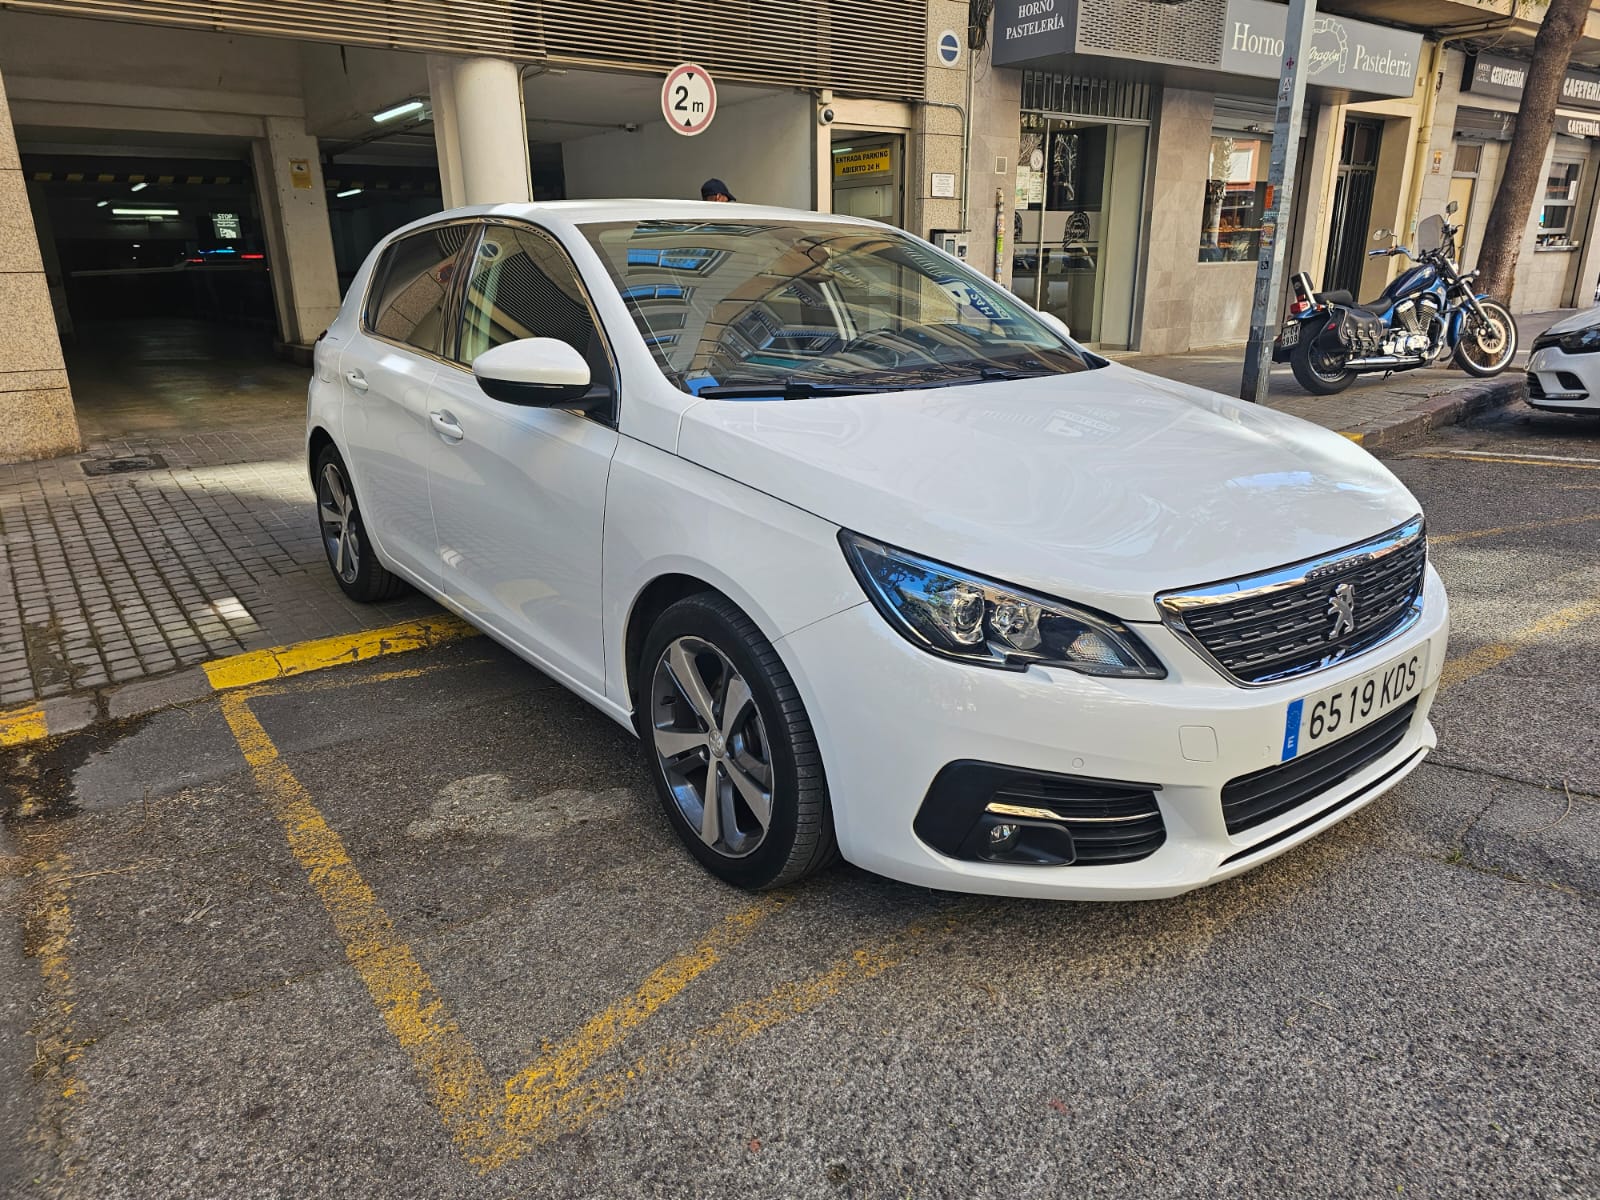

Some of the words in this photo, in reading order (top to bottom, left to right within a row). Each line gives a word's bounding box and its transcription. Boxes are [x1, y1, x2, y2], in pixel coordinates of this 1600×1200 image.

[1018, 0, 1054, 18] HORNO
[1006, 13, 1064, 39] PASTELERÍA
[1232, 22, 1284, 57] Horno
[674, 85, 689, 111] 2
[692, 101, 704, 113] m
[836, 154, 862, 164] ENTRADA
[862, 150, 888, 161] PARKING
[842, 164, 866, 174] ABIERTO
[875, 162, 880, 170] H
[1309, 679, 1375, 740] 6519
[1380, 655, 1418, 709] KDS
